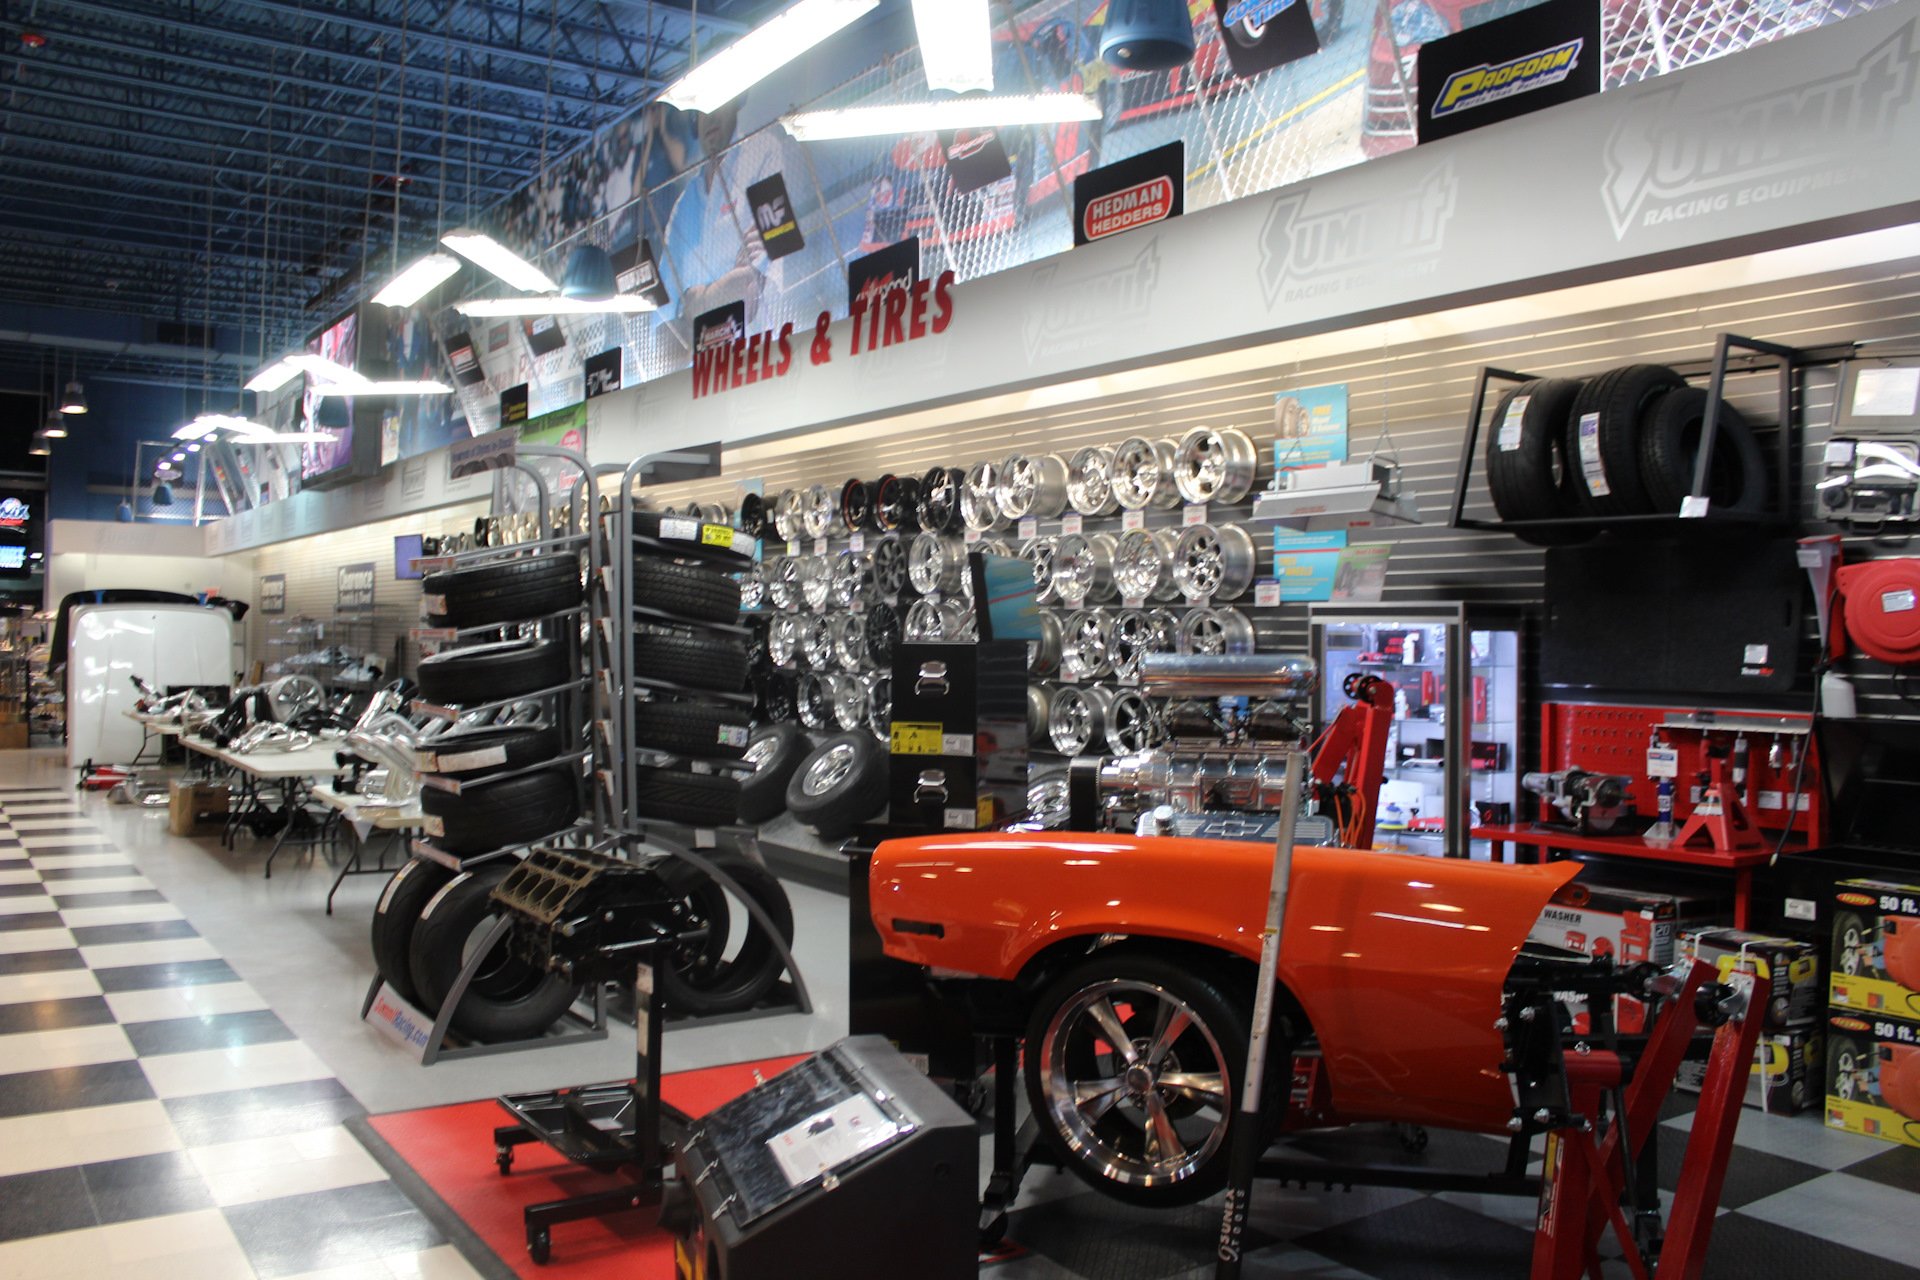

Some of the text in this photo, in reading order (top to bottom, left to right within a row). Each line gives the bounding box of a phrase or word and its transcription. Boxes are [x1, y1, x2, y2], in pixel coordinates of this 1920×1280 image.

[1440, 46, 1577, 108] PROFORM
[1092, 183, 1164, 220] HEDMAN
[1642, 193, 1728, 227] RACING
[1092, 202, 1164, 235] HEDDERS
[692, 270, 955, 399] WHEELS & TIRES
[1543, 909, 1583, 924] WASHER
[1879, 895, 1899, 911] 50
[1901, 898, 1919, 914] ft.
[1655, 924, 1672, 938] 20
[1874, 1021, 1894, 1038] 50
[1896, 1025, 1914, 1042] ft.
